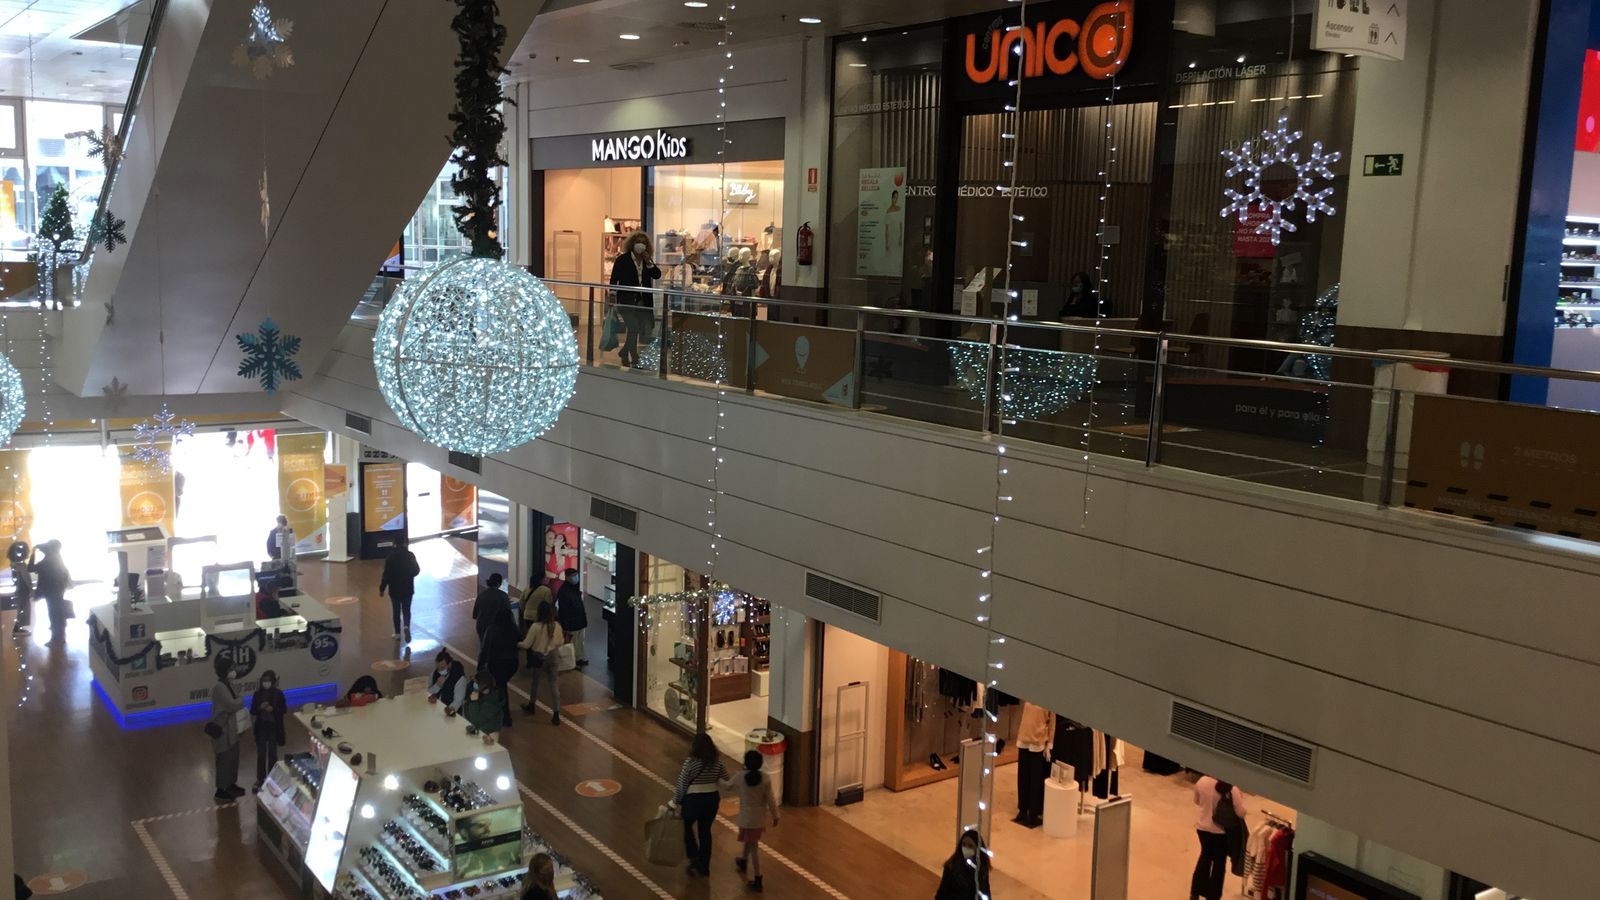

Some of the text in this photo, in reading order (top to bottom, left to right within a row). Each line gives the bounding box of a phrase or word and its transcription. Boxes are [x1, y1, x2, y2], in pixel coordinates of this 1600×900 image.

[1326, 20, 1355, 33] Ascensor
[1235, 64, 1267, 77] LÁSER
[592, 134, 655, 162] MANGO
[957, 183, 994, 198] ÉDICO
[1234, 403, 1257, 415] para
